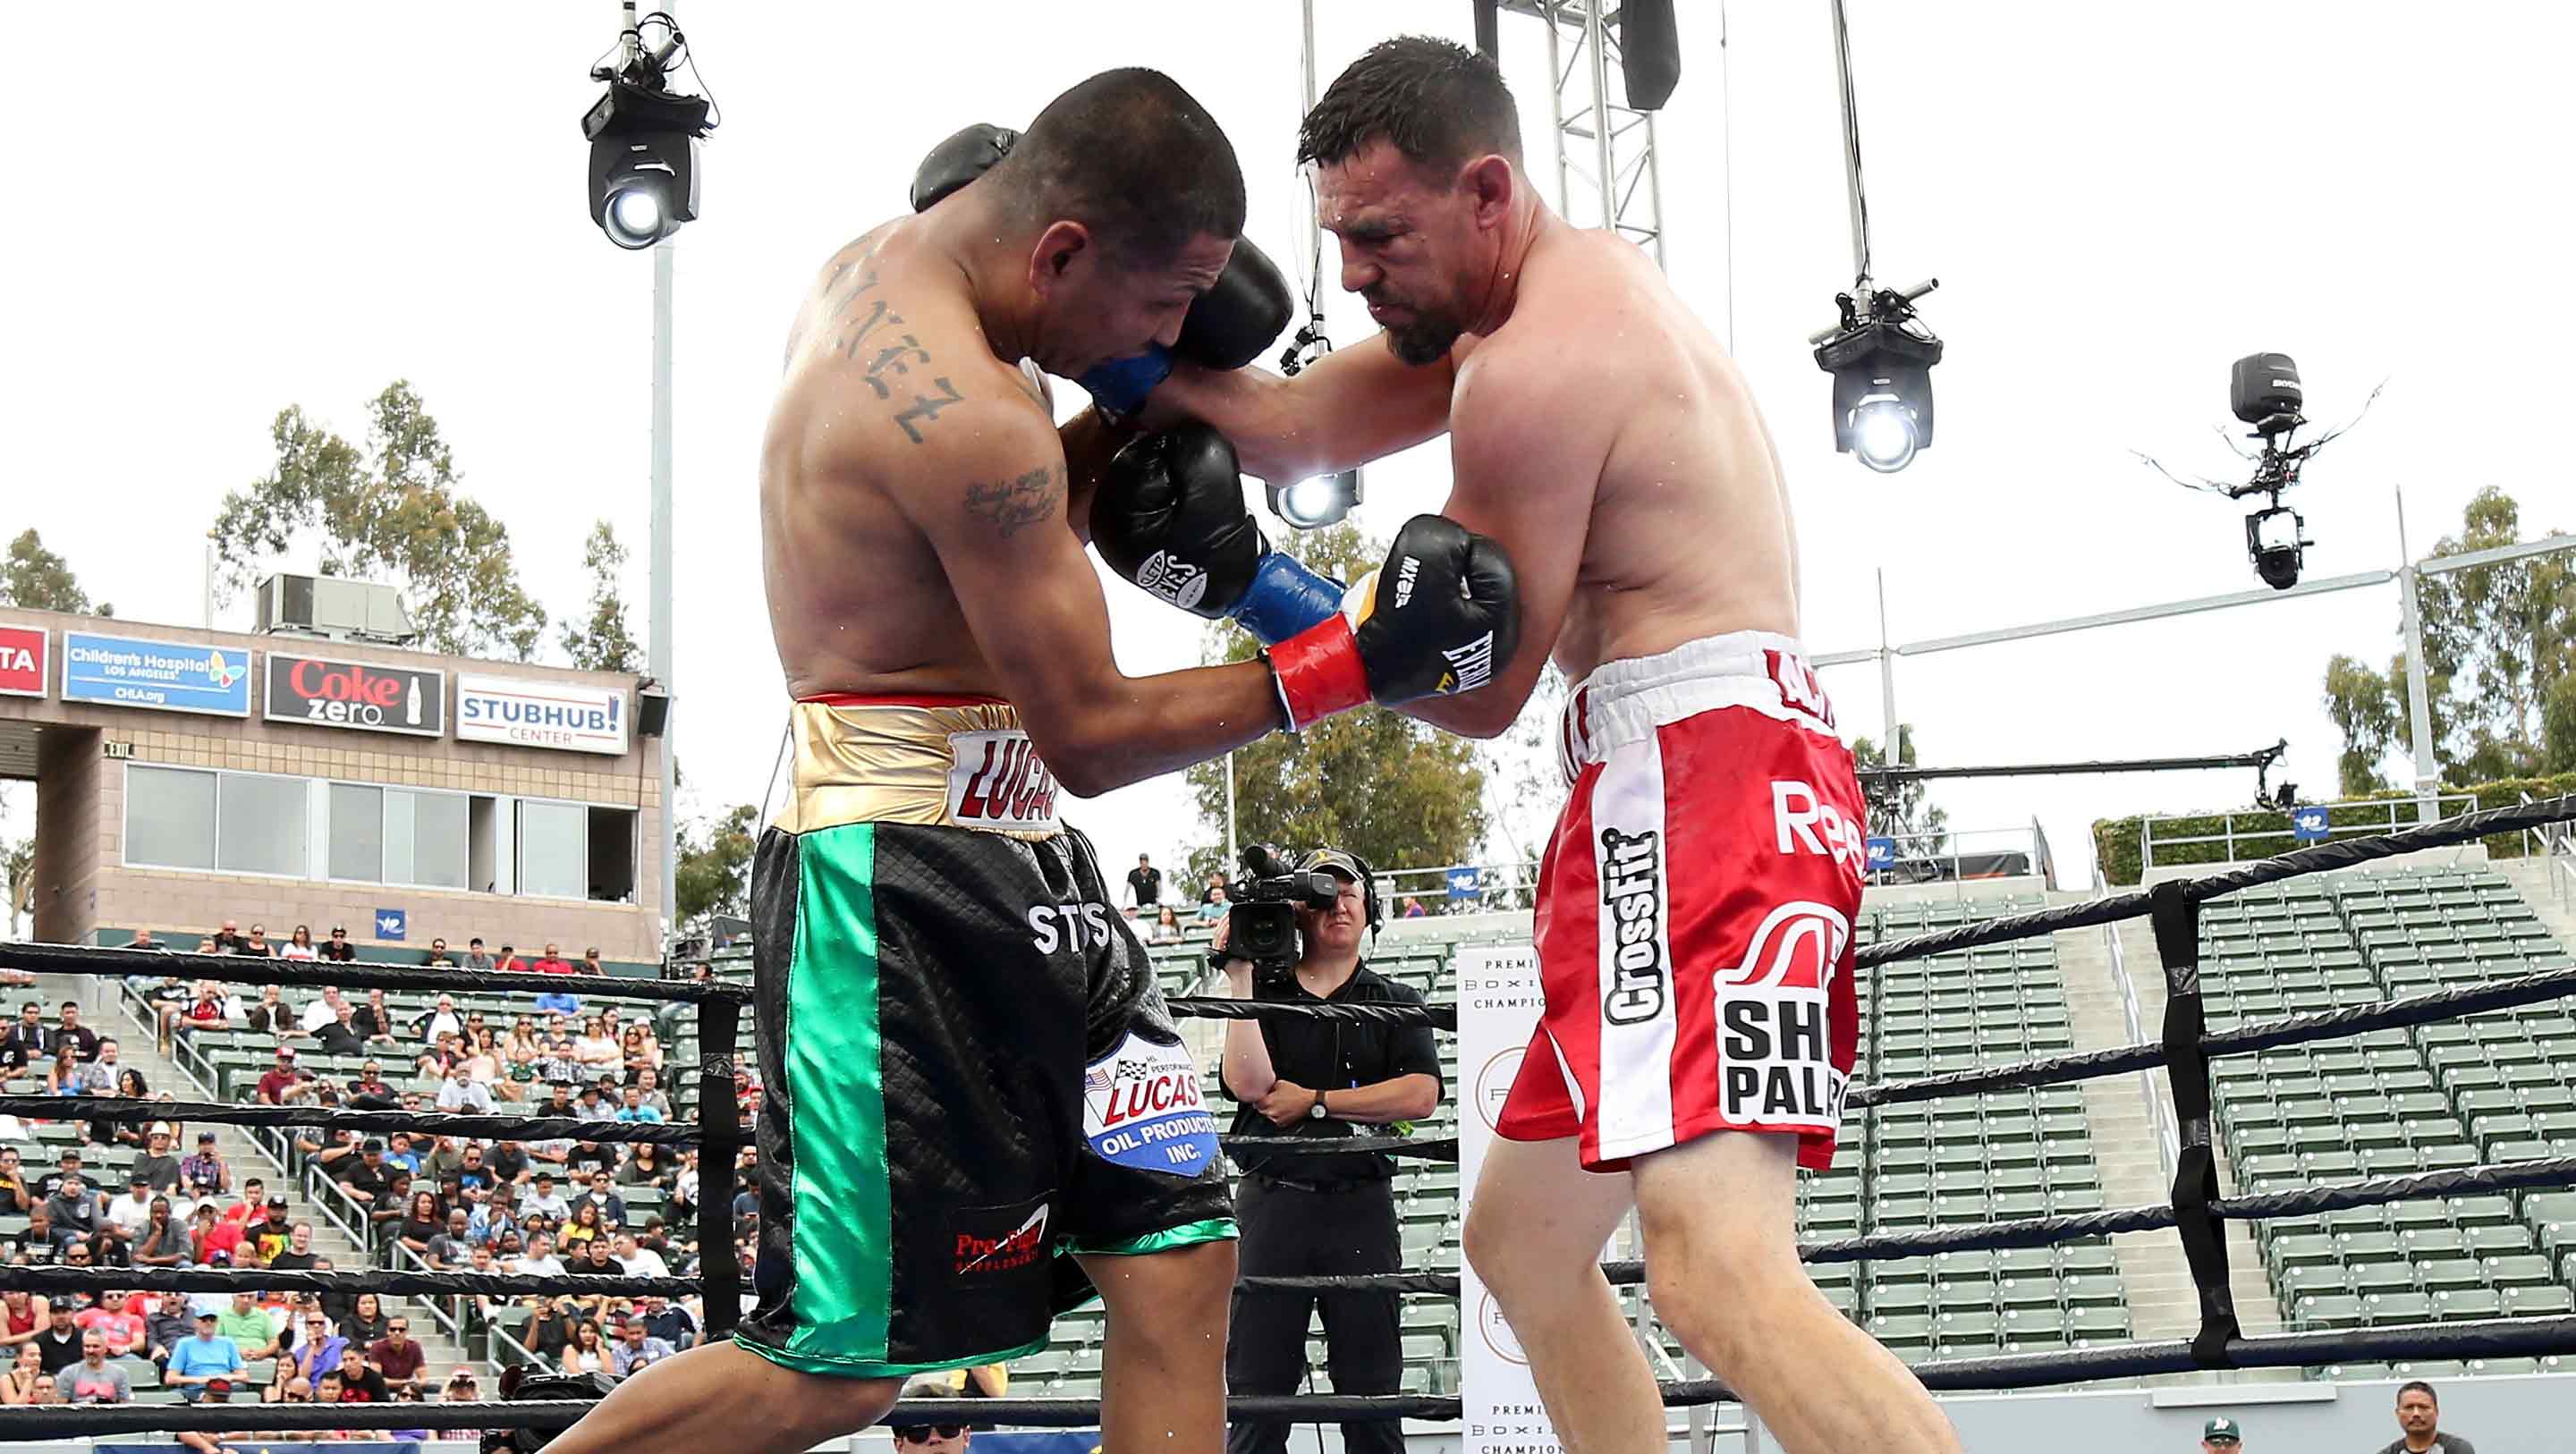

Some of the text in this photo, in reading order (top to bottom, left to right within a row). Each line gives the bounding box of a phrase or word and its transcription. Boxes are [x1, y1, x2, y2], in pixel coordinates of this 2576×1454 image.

[0, 647, 37, 672] TA
[70, 647, 209, 673] Children's Hospital
[105, 665, 176, 681] LOS ANGELES
[290, 660, 402, 706] Coke
[114, 686, 165, 704] CHLA.org
[308, 697, 382, 725] zero
[463, 695, 619, 731] STUBHUB!
[509, 727, 572, 746] CENTER
[109, 743, 131, 758] EXIT
[1605, 833, 1663, 1025] CrossFit
[1485, 959, 1534, 970] PREMI
[1464, 979, 1535, 992] BOXI
[1473, 997, 1546, 1010] CHAMPIO
[1724, 1000, 1823, 1062] SH
[1103, 1074, 1199, 1128] LUCAS
[1101, 1115, 1216, 1155] OIL PRODUCTS
[1165, 1142, 1202, 1164] INC.
[1493, 1405, 1542, 1416] PREMI
[1471, 1424, 1543, 1437] BOXI
